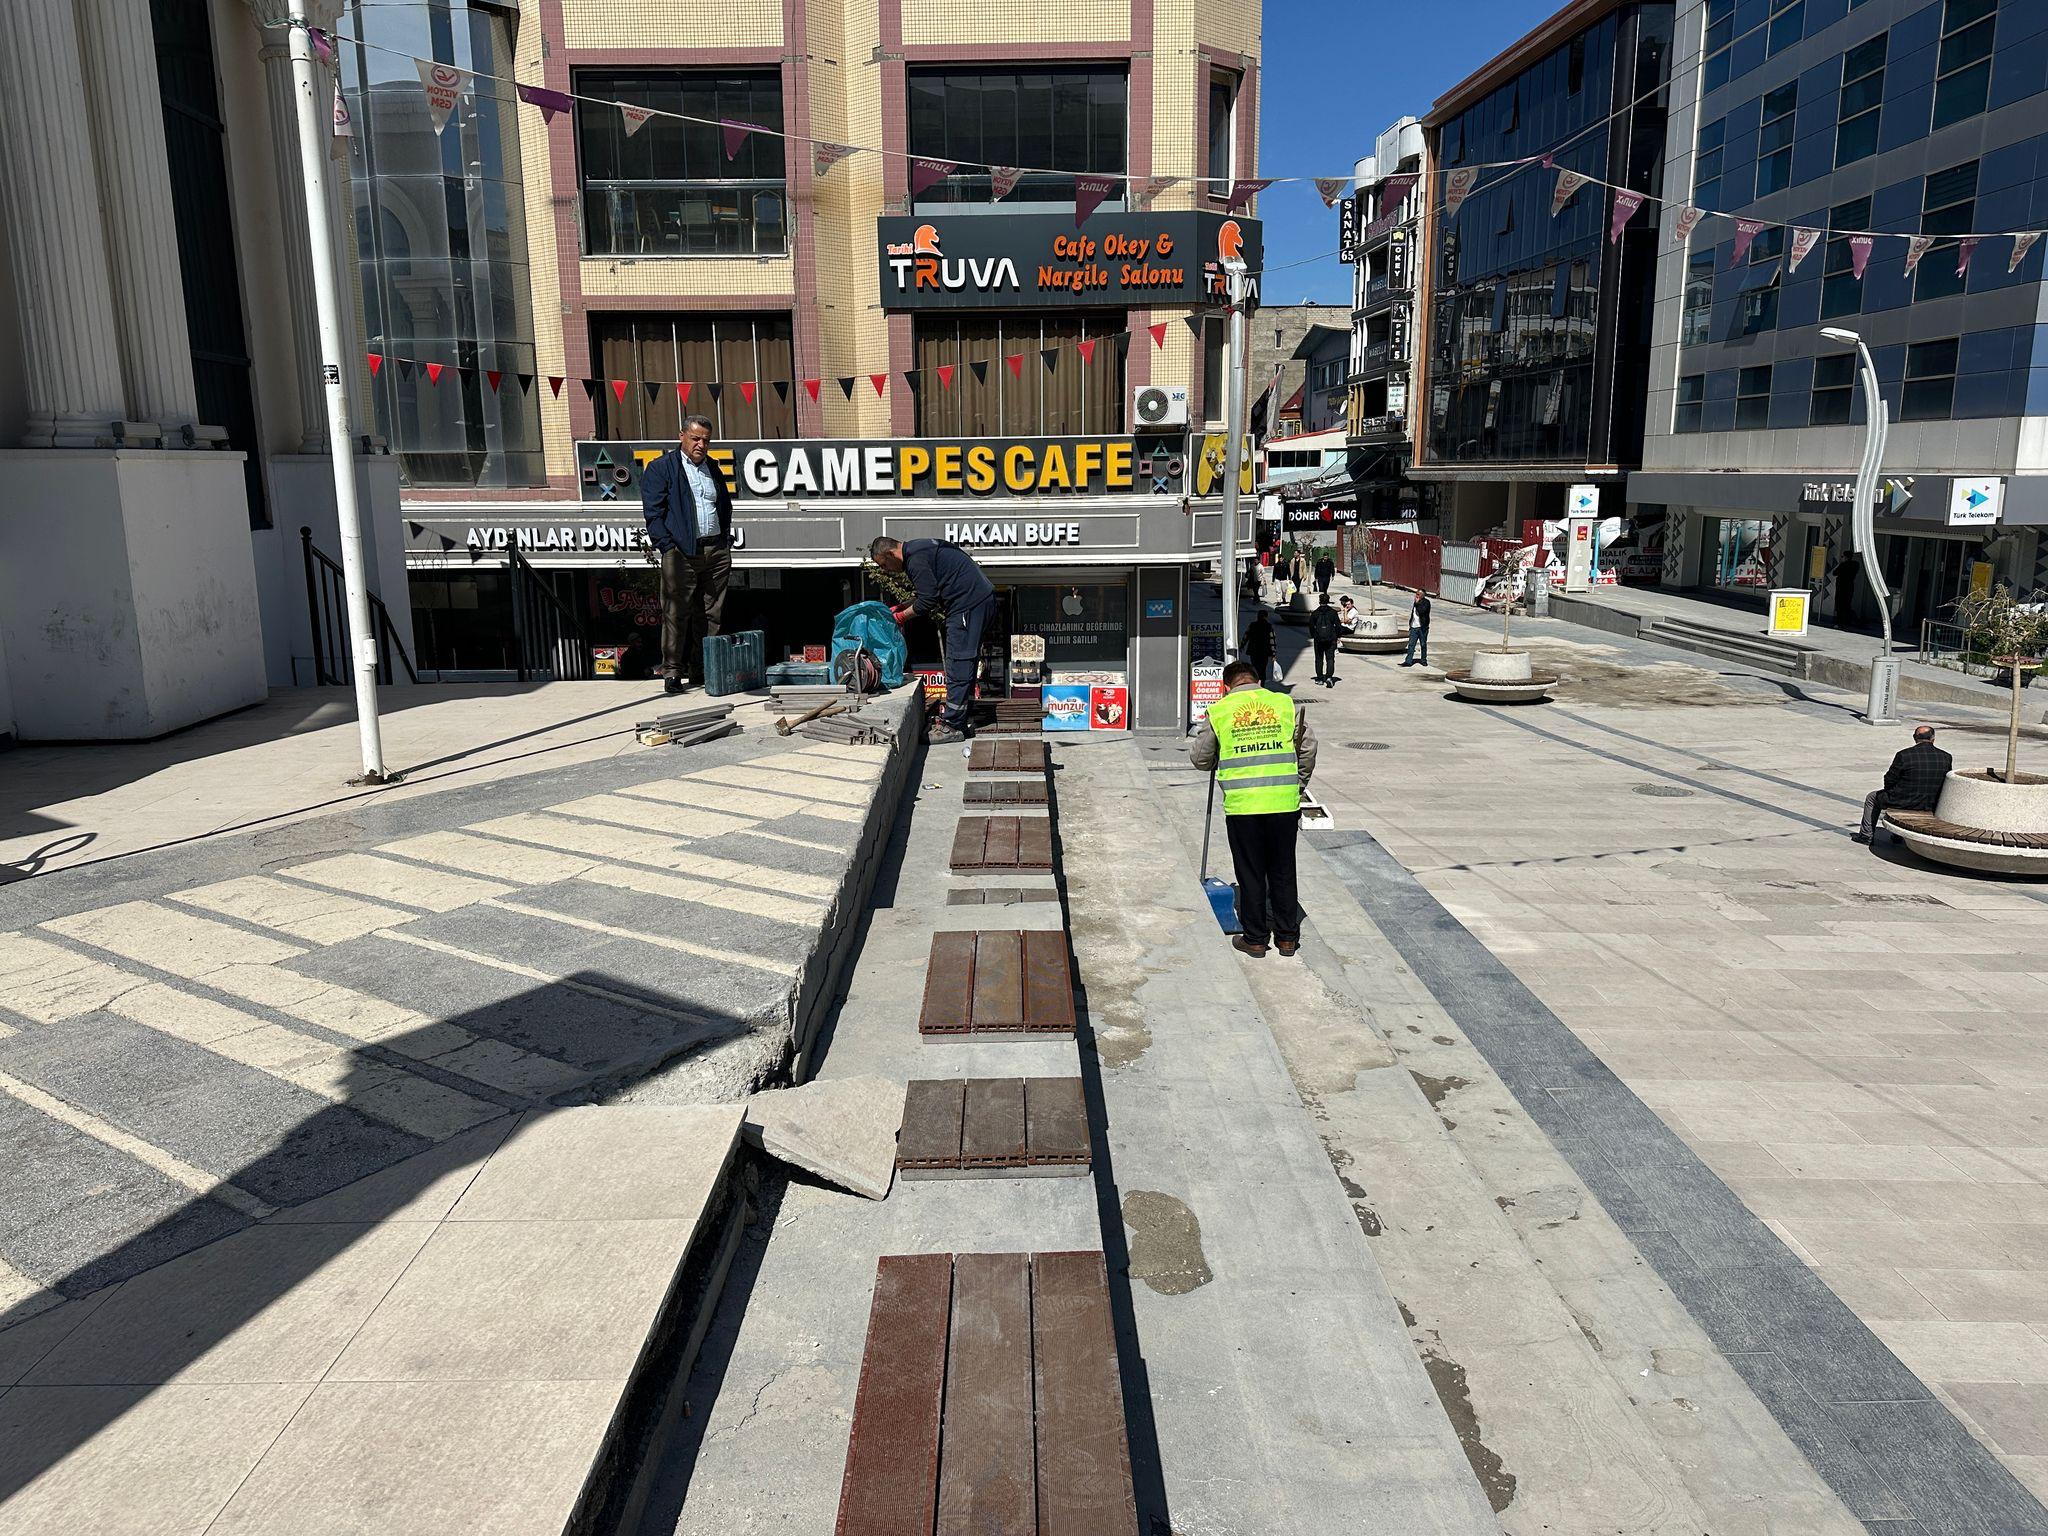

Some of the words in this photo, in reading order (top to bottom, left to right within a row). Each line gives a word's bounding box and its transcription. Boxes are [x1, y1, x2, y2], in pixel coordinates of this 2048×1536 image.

[1343, 200, 1353, 249] SANAT
[887, 243, 914, 255] Tarihi
[1053, 234, 1096, 260] Cafe
[1103, 234, 1150, 260] Okey
[1156, 233, 1173, 254] &
[1341, 250, 1354, 261] 65
[889, 257, 1020, 288] TRUVA
[1037, 264, 1108, 289] Nargile
[1120, 264, 1184, 285] Salonu
[633, 449, 737, 493] TE
[1288, 509, 1320, 521] DÖNER
[1333, 509, 1357, 520] KING
[466, 527, 575, 548] AYDNLAR
[944, 523, 1018, 543] HAKAN
[930, 671, 947, 686] BÜ
[1193, 668, 1222, 677] SANAT
[1047, 702, 1086, 711] munzur
[1233, 740, 1283, 754] TEMİZLİK
